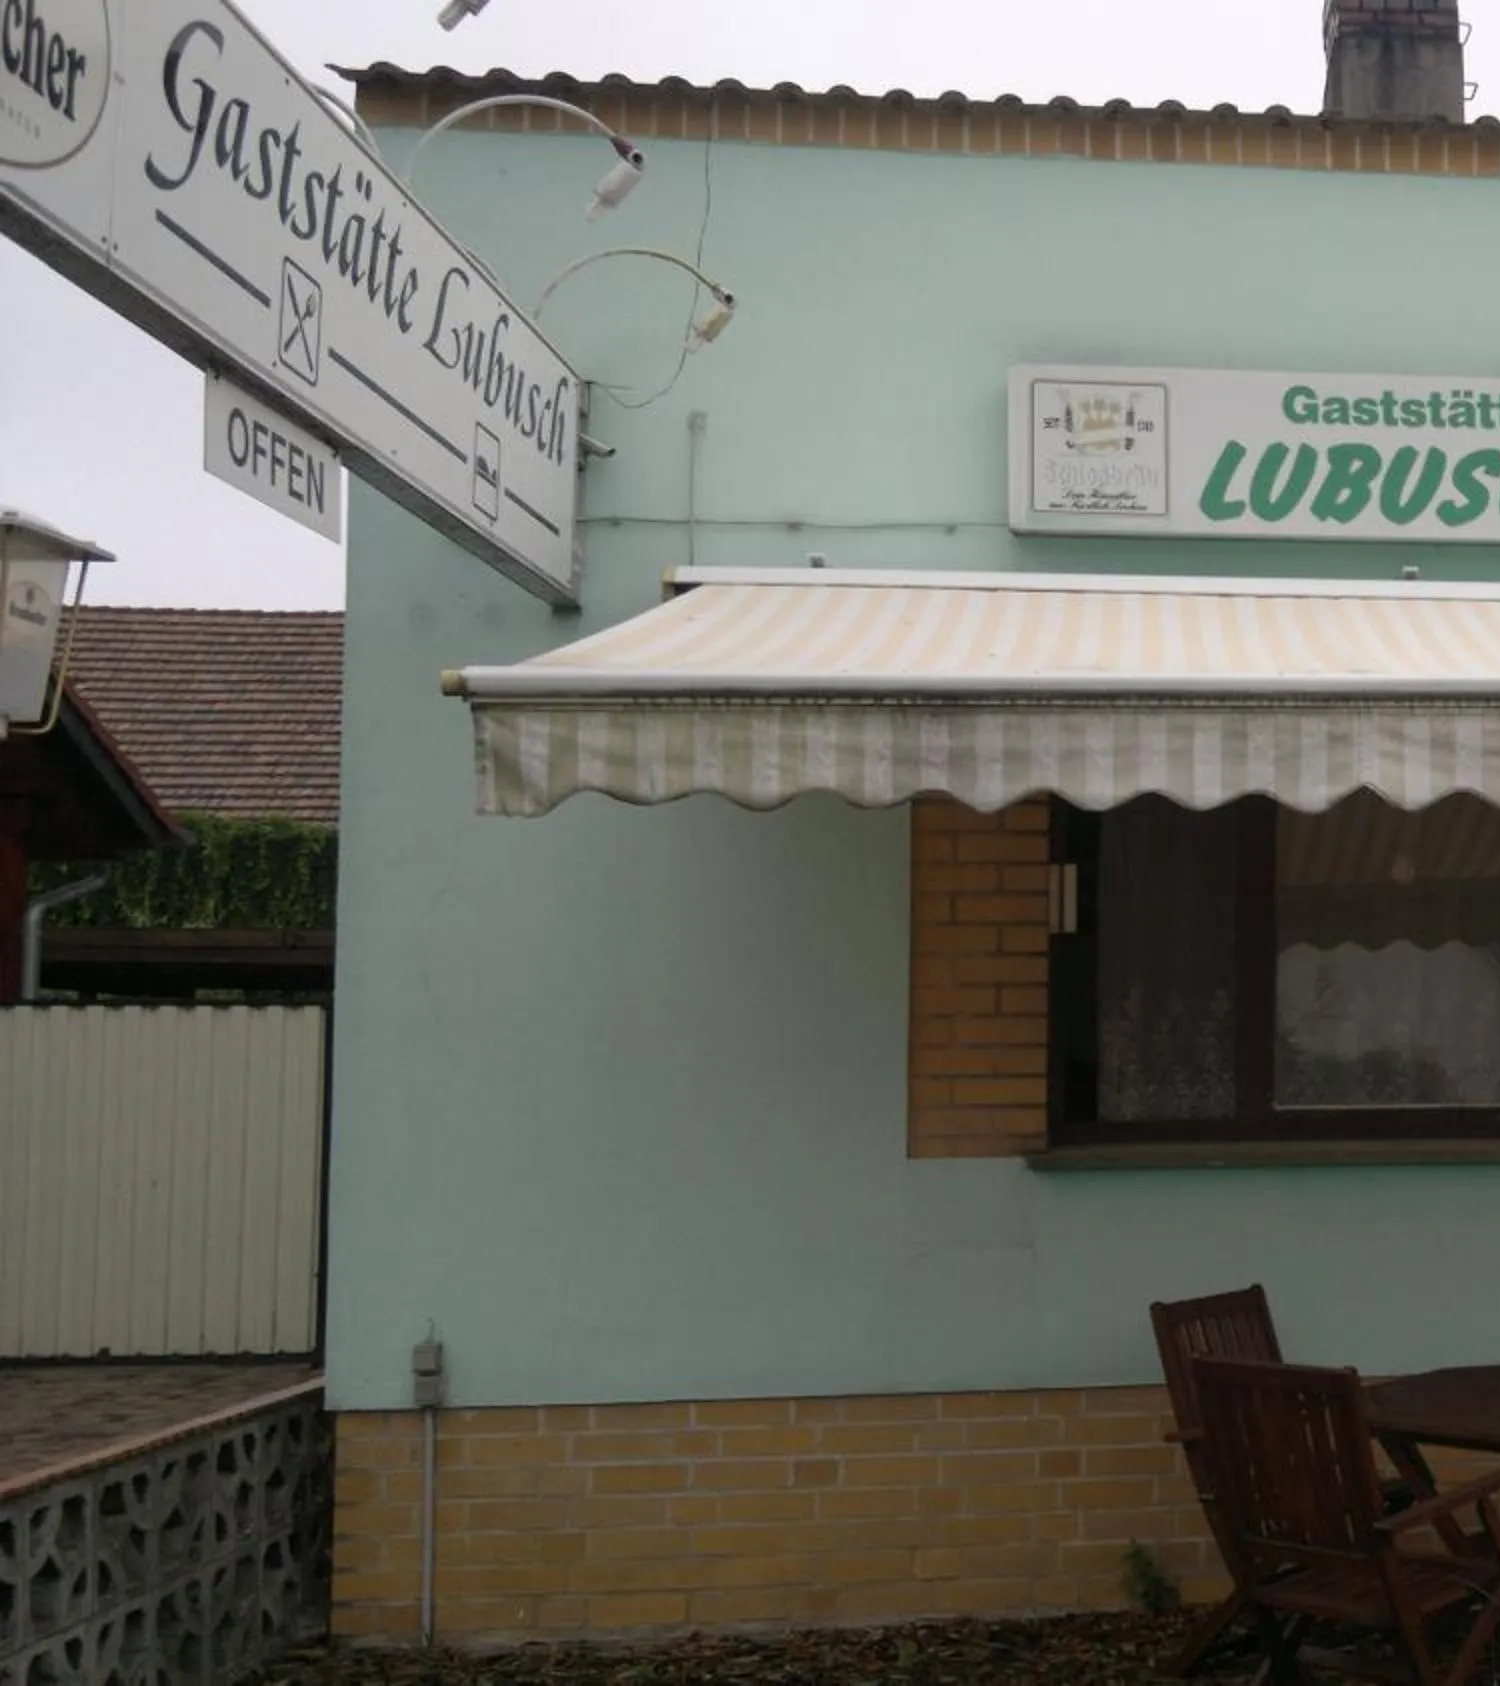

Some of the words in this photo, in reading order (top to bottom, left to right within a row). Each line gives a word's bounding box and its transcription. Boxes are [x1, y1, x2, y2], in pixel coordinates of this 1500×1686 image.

[2, 0, 86, 122] cher
[144, 20, 418, 333] Gaststätte
[422, 267, 568, 466] Lubusch
[227, 407, 325, 514] OFFEN
